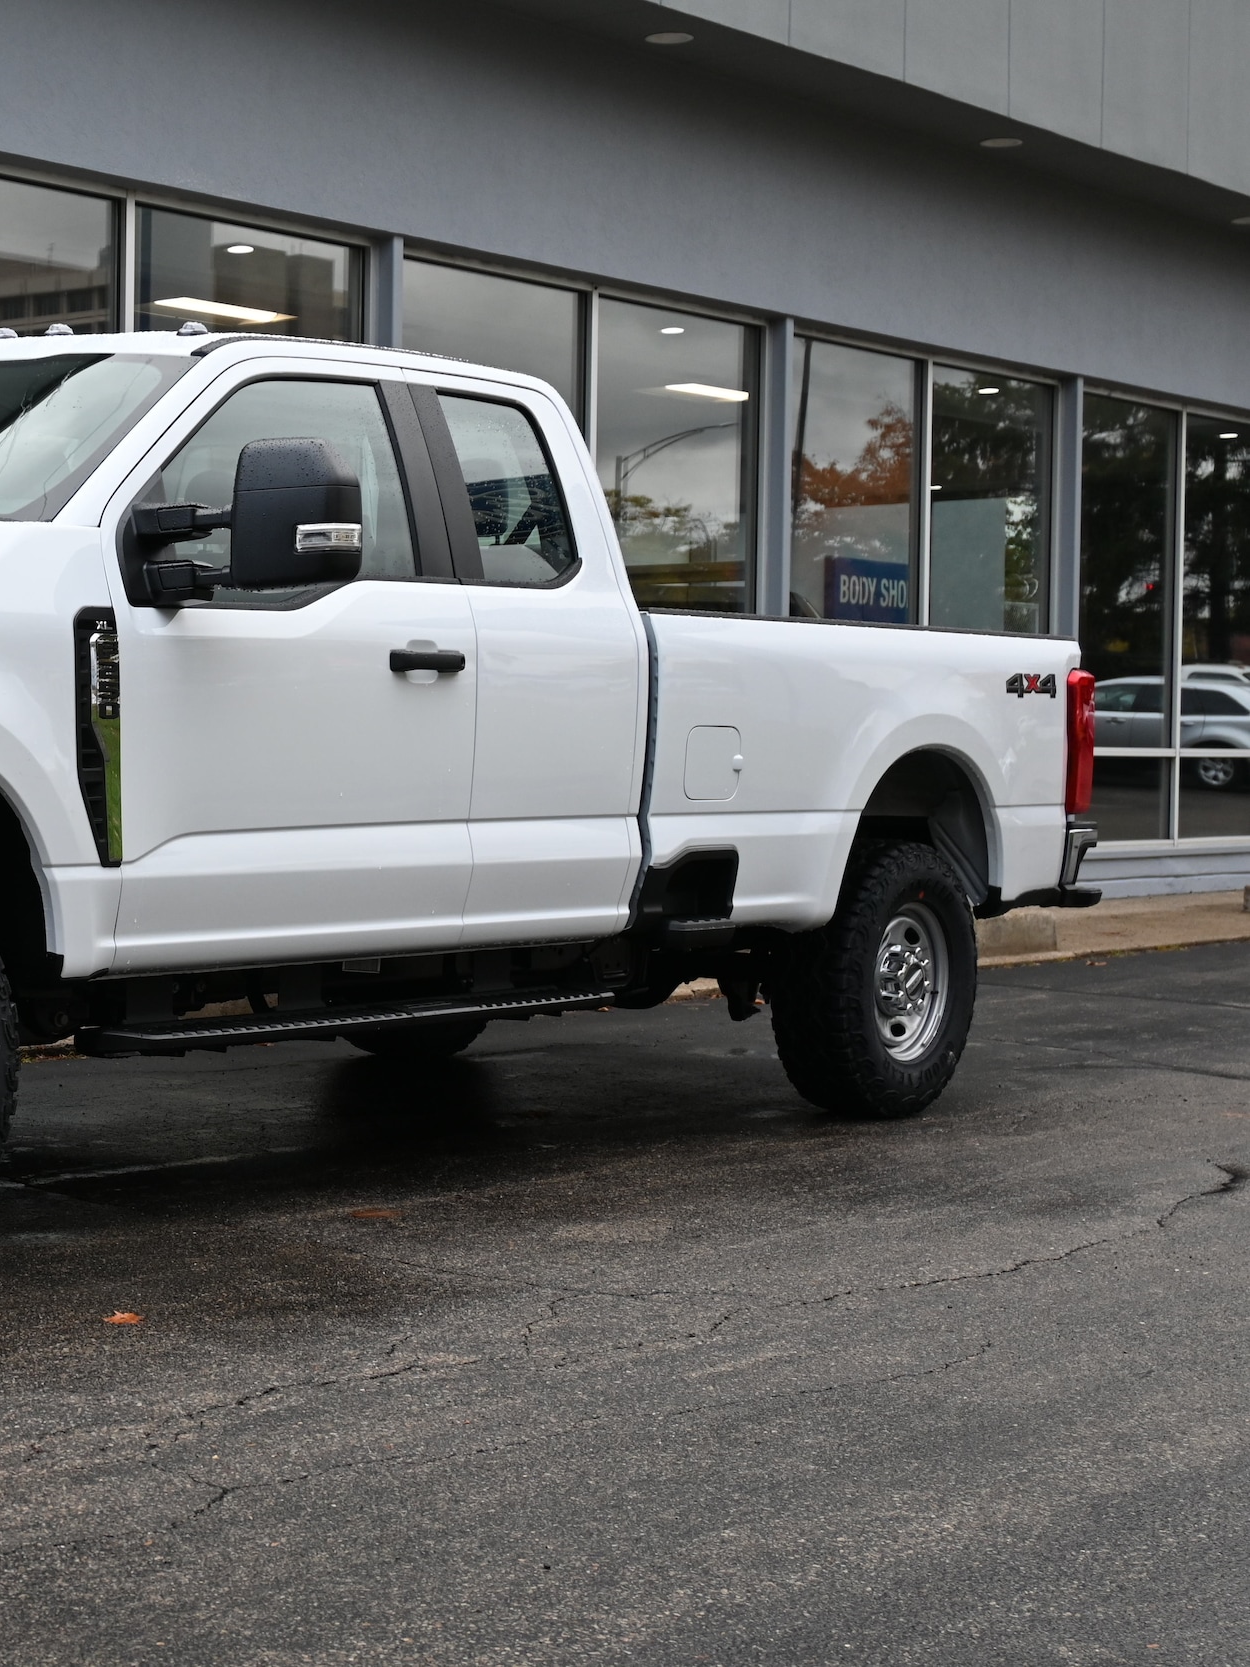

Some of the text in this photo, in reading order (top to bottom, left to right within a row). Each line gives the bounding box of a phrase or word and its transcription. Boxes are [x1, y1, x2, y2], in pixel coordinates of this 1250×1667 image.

[839, 574, 909, 609] BODY SHO
[95, 620, 113, 630] XL
